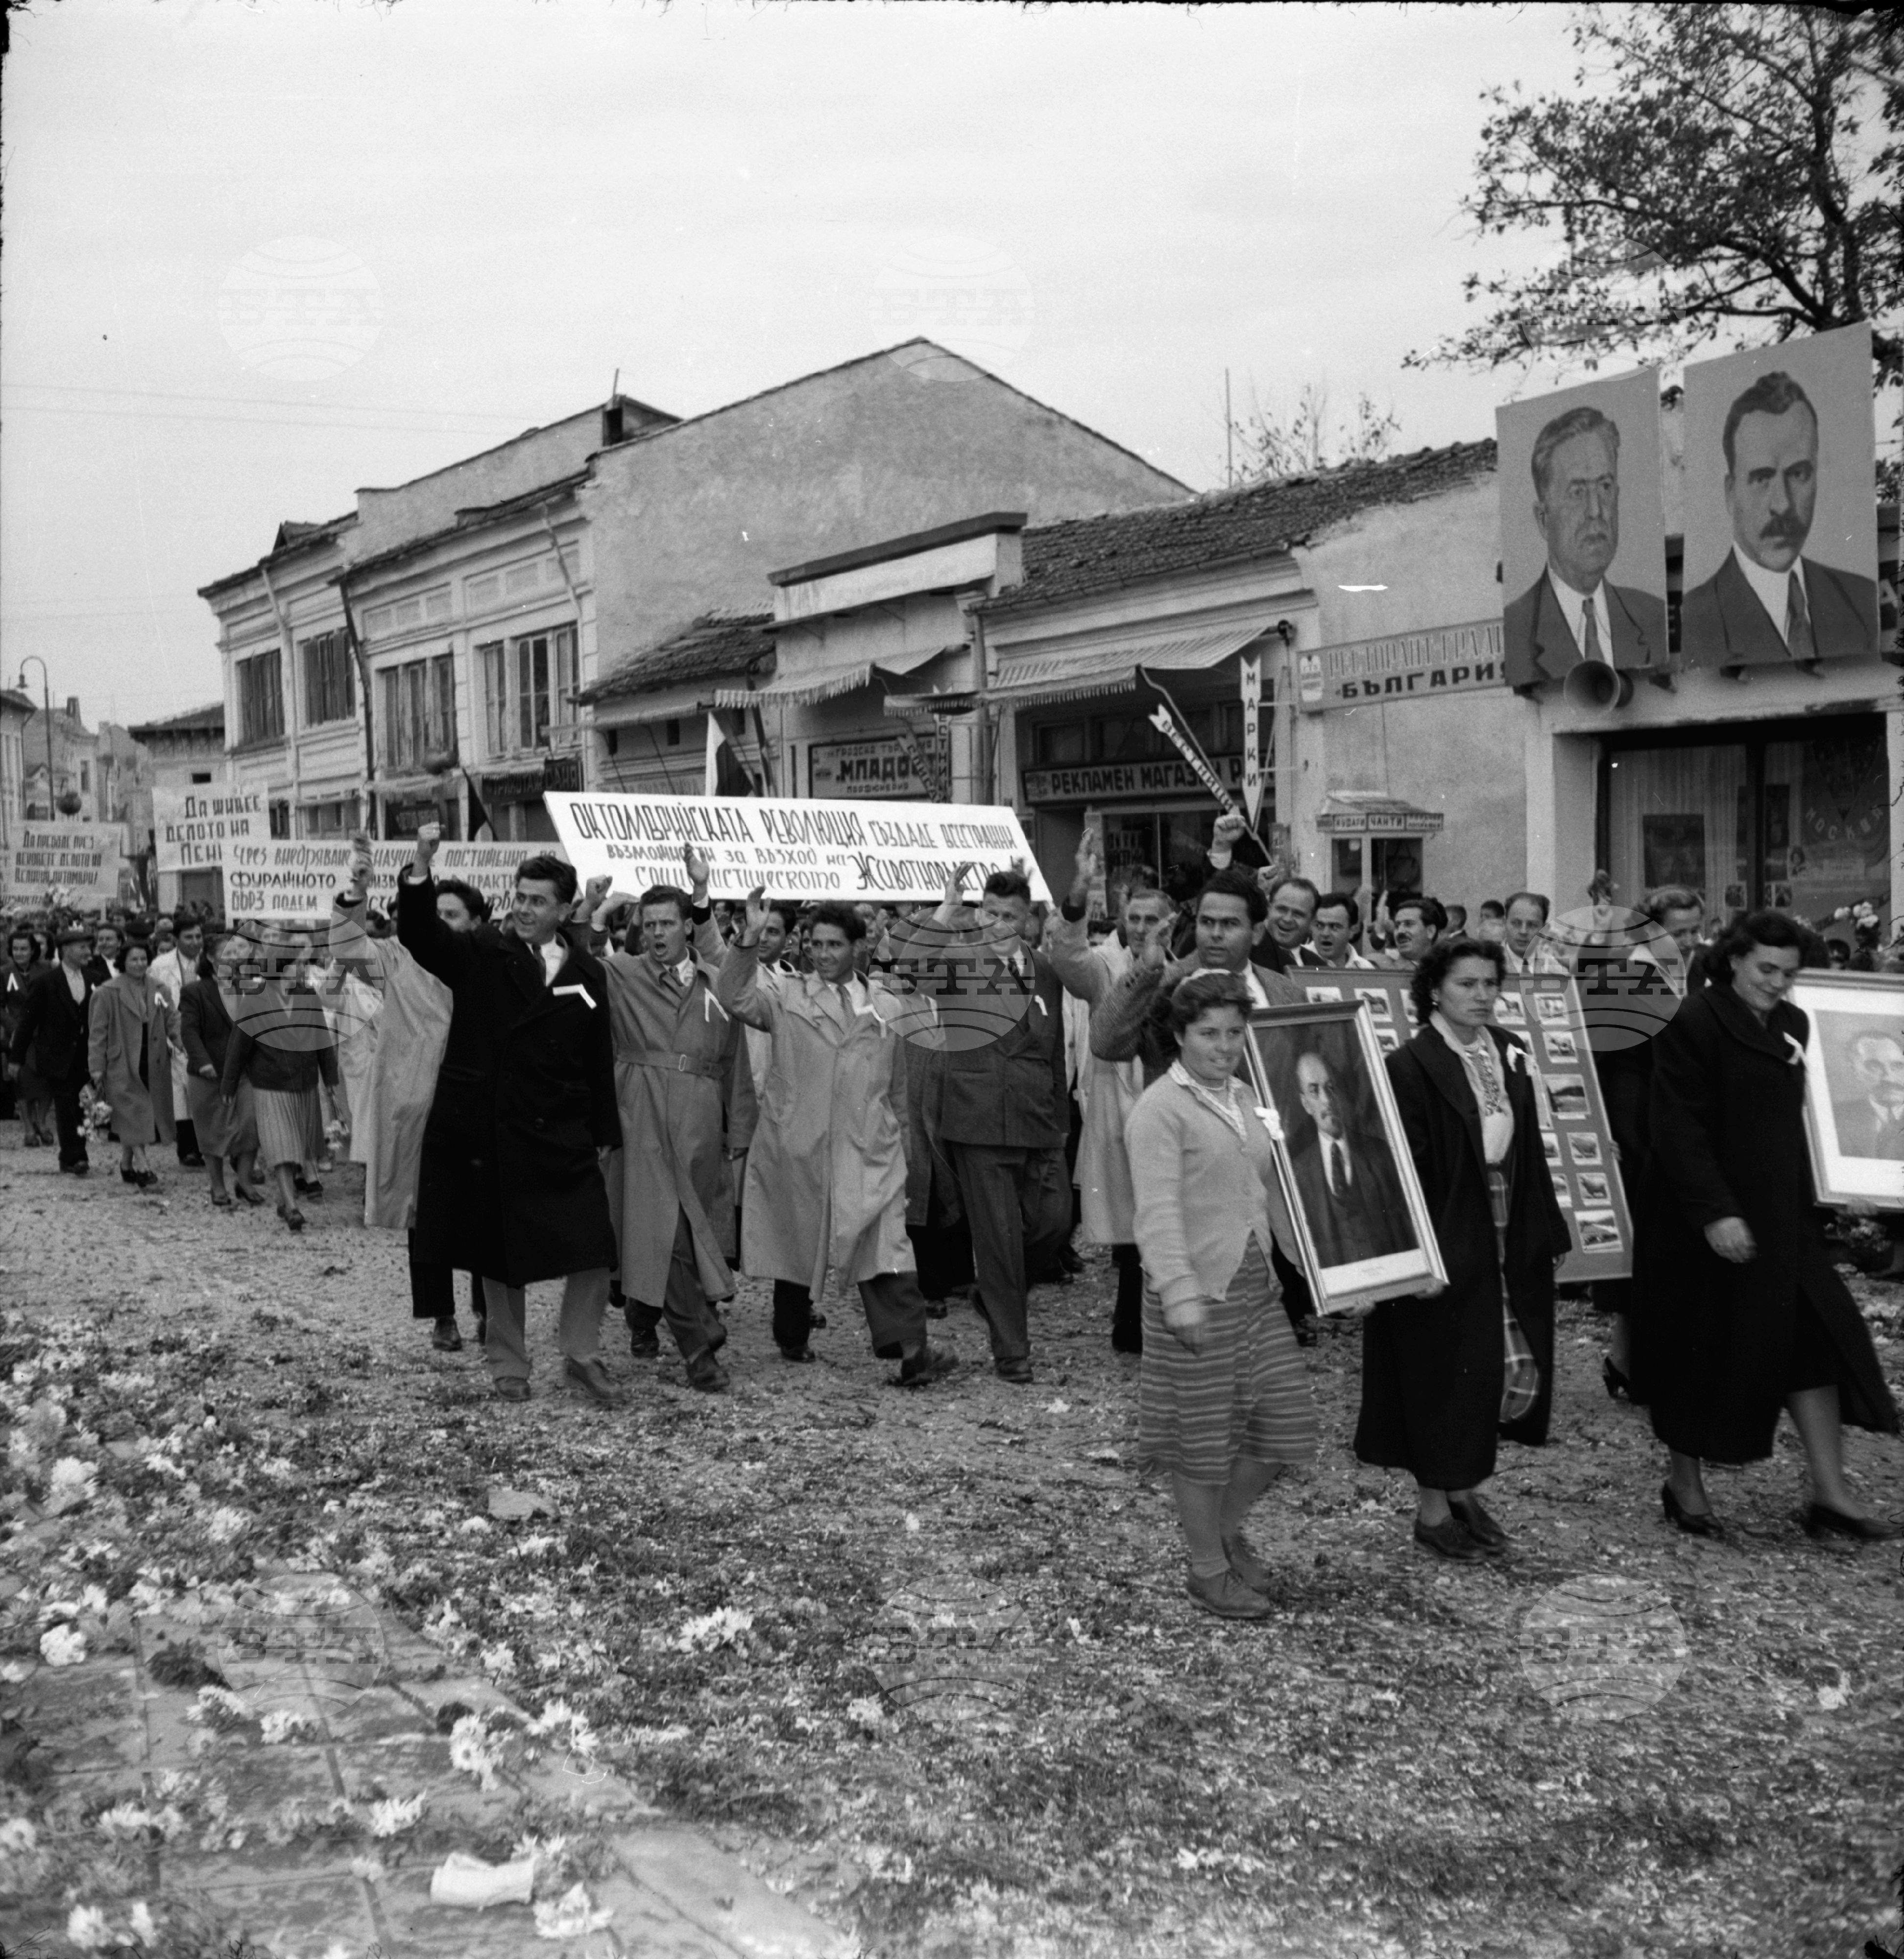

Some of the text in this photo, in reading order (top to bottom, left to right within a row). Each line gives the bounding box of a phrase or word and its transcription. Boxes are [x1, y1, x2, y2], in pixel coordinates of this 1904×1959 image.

[1247, 671, 1256, 787] МАРКИ
[1051, 765, 1133, 795] РЕКЛАМЕН
[166, 818, 249, 842] ДЕЛОТО НА
[569, 801, 1017, 850] ОКТОМВРИЙСКАТА РЕВОЛЮЦИЯ СЪЗДАДЕ ВСЕСТРАННИ
[1371, 816, 1402, 828] ЧАНТИ
[230, 870, 336, 889] ФУРАЖНОТО
[231, 890, 317, 911] БЪРЗ ПОДЕМ
